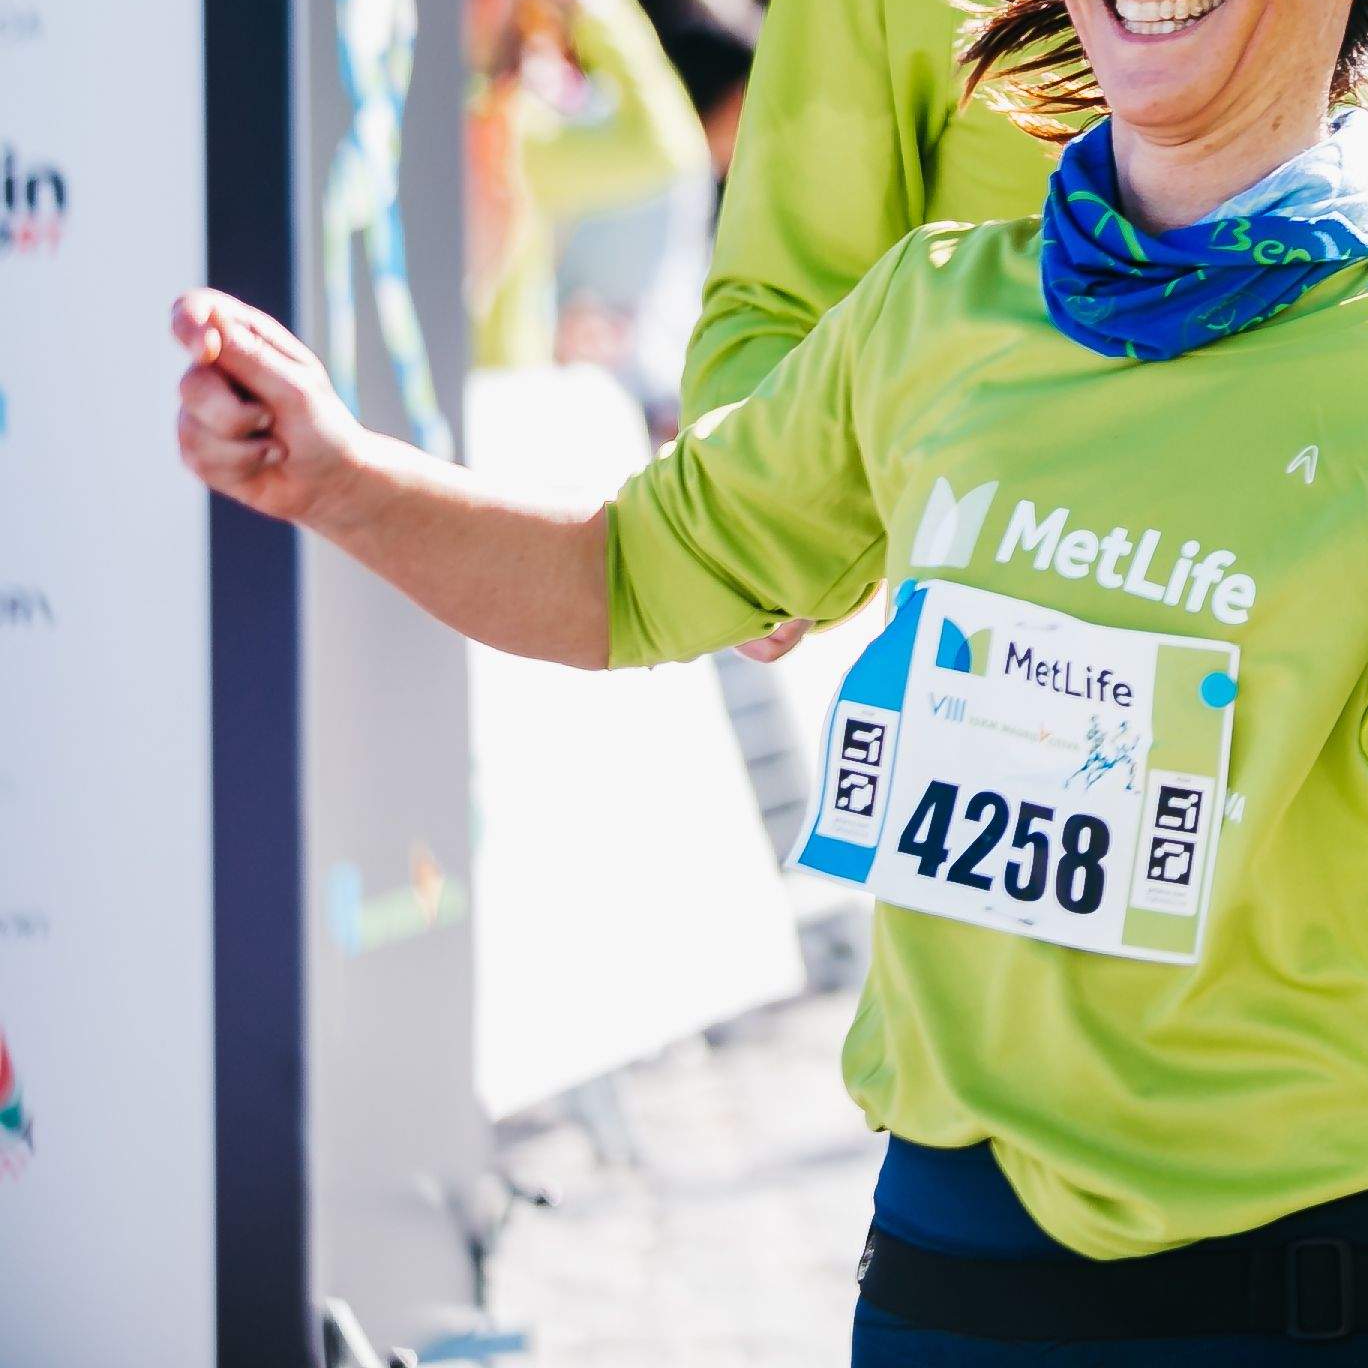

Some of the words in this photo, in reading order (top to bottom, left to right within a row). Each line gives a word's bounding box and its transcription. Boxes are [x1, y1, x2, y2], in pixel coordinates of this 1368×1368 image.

[995, 500, 1257, 624] MetLife
[1004, 640, 1134, 708] MetLife
[897, 779, 1111, 914] 4258
